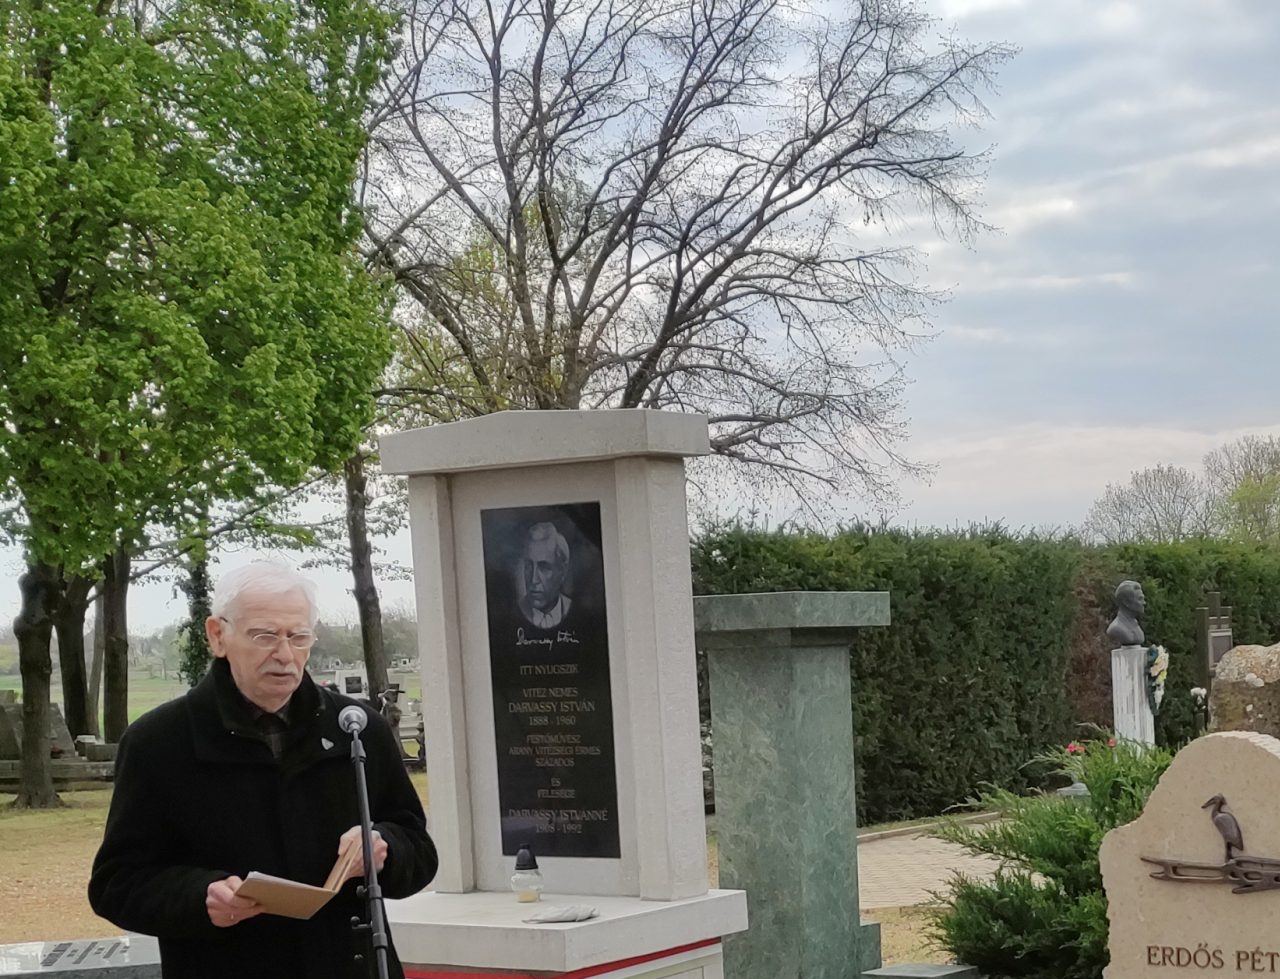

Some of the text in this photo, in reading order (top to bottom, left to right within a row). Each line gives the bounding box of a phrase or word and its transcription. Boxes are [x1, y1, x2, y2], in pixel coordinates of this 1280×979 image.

[520, 664, 533, 675] ITT
[508, 698, 596, 713] DARVASSY ISTVÁN
[1146, 943, 1225, 970] ERDŐS
